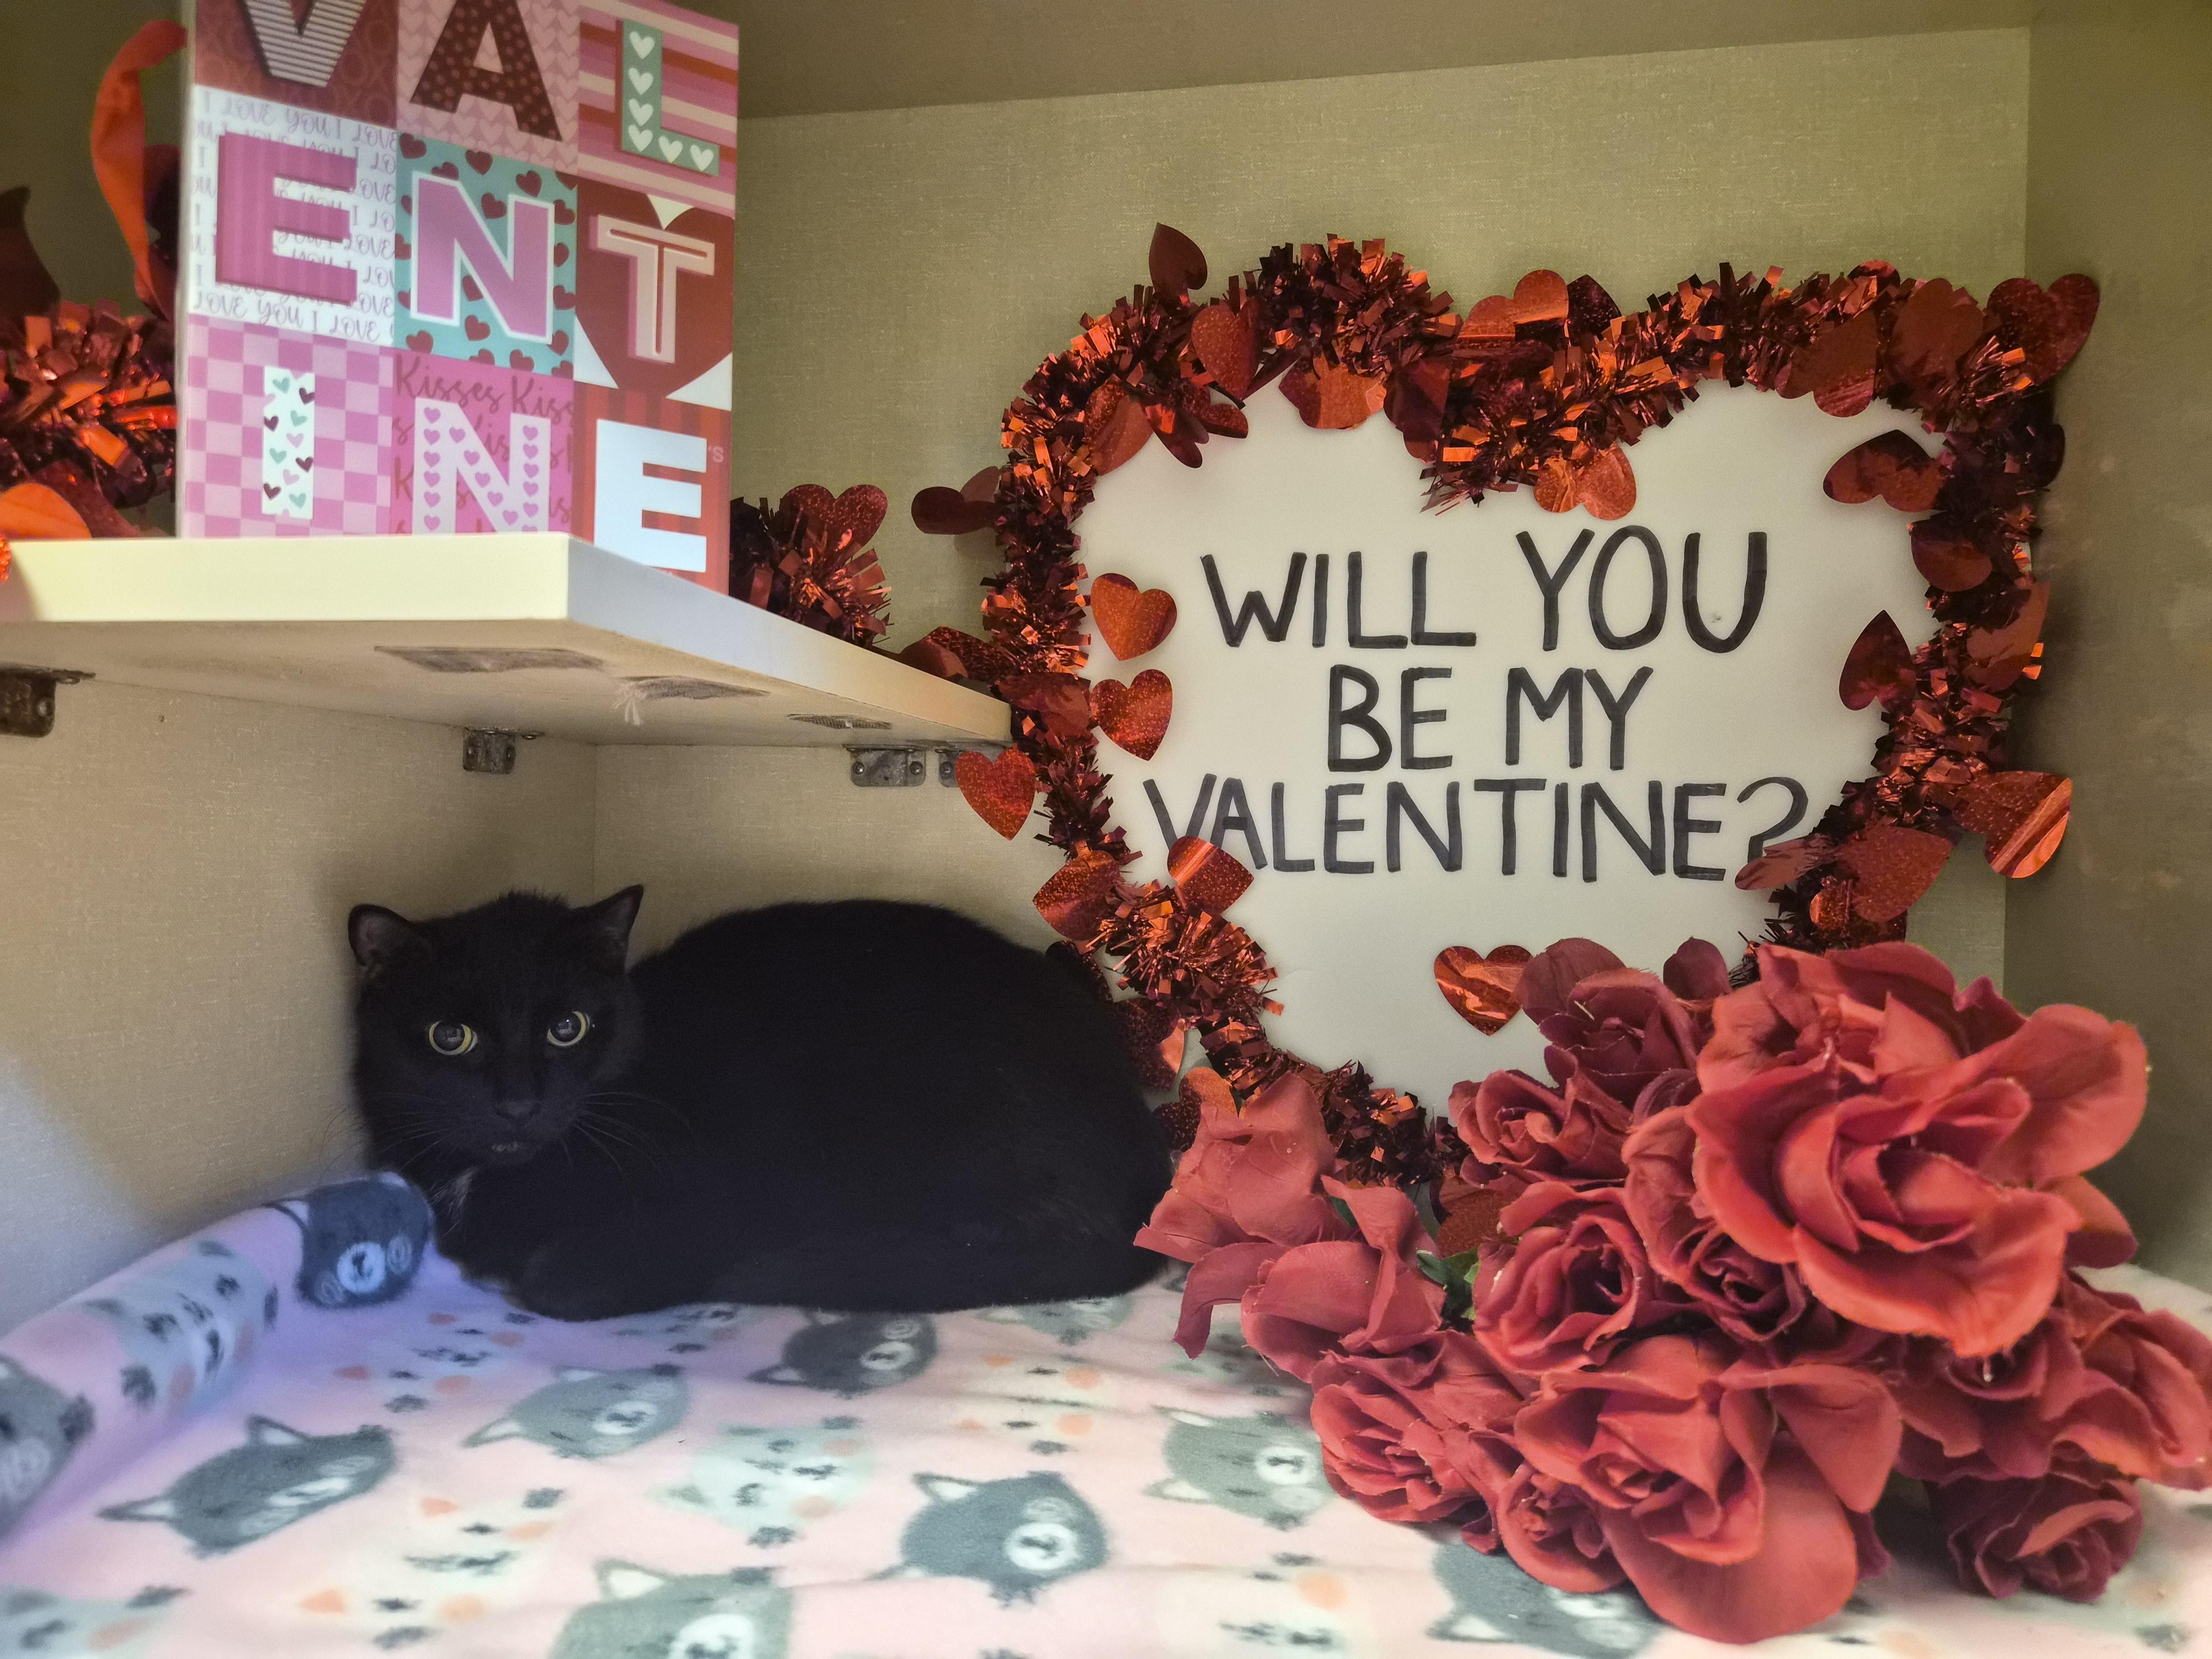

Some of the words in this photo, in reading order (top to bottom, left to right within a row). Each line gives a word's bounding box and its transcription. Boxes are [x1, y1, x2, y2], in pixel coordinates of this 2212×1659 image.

[360, 179, 396, 204] OVE
[359, 293, 394, 318] OVE
[395, 354, 507, 414] Kisses
[1199, 551, 1477, 649] WILL
[1516, 524, 1768, 654] YOU
[1327, 664, 1453, 772] BE
[1505, 666, 1654, 771] MY
[1142, 773, 1809, 883] VALENTINE?
